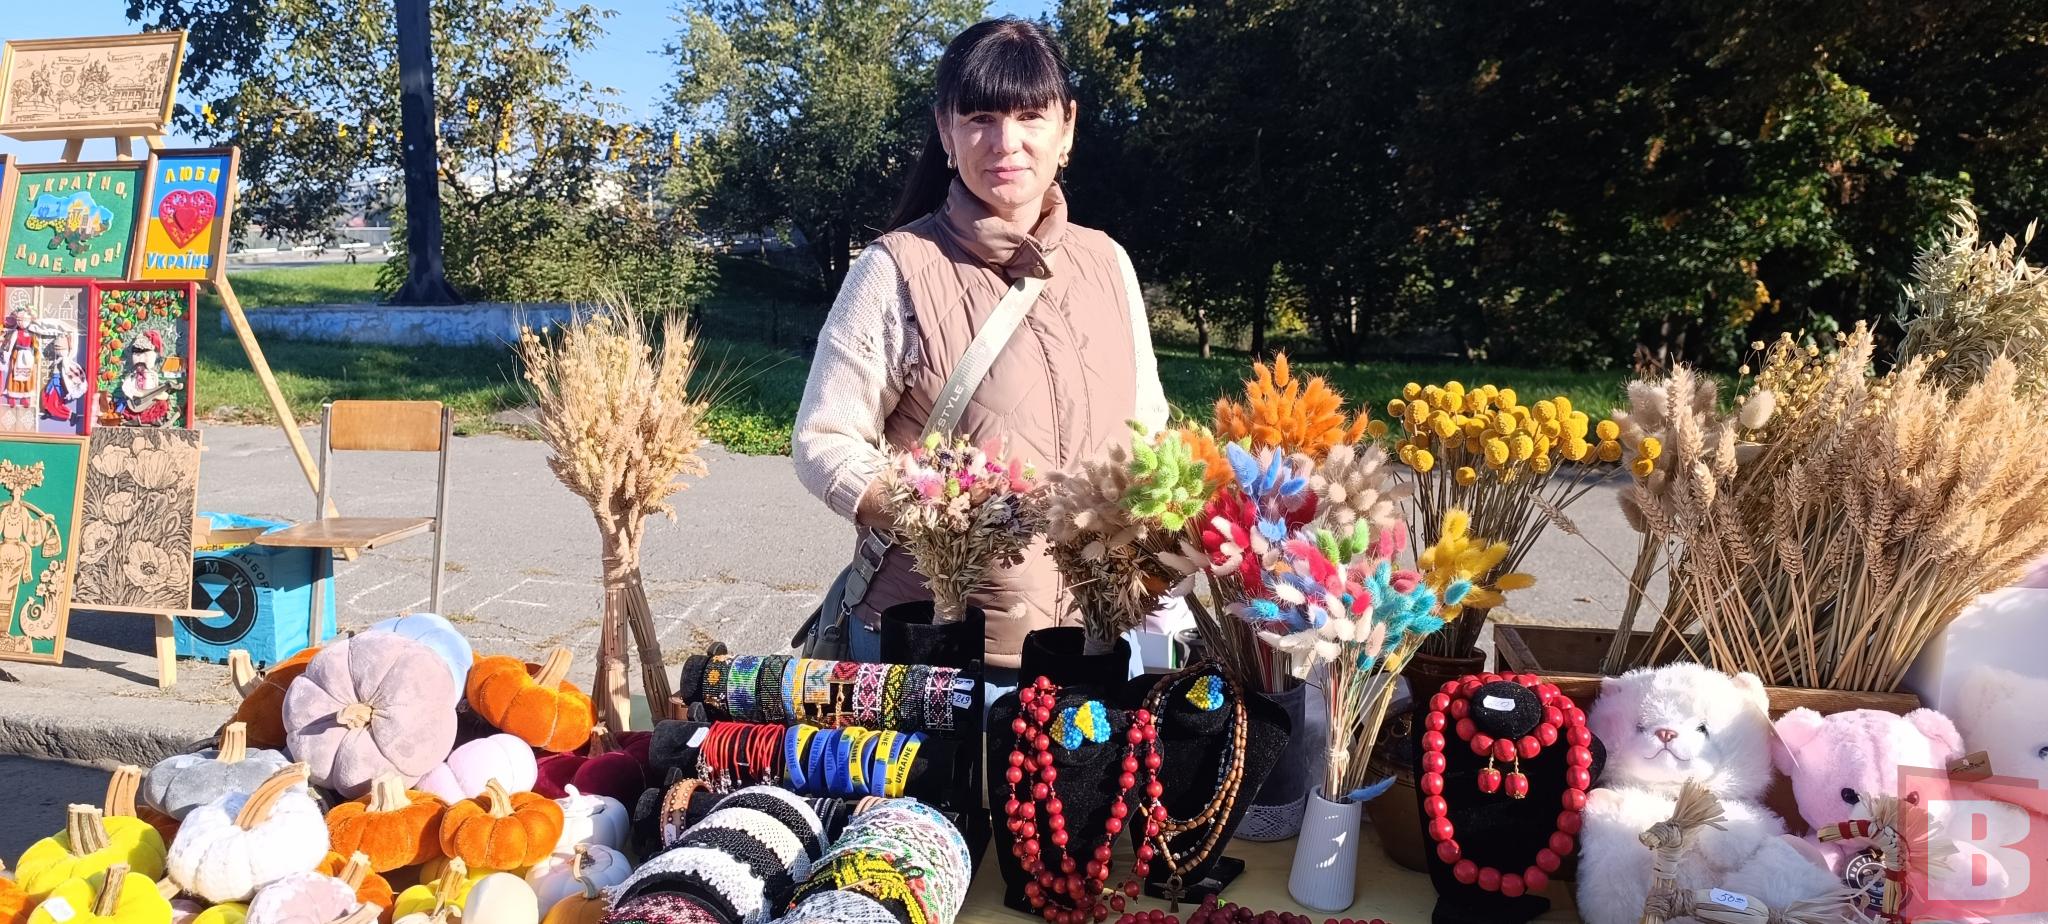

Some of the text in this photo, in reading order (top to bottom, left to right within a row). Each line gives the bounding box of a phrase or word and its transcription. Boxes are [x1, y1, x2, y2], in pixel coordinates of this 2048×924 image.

[164, 166, 220, 184] ЛЮБИ
[73, 242, 121, 272] МОЯ!
[938, 384, 964, 428] STYLE
[895, 746, 913, 784] UKRAINE
